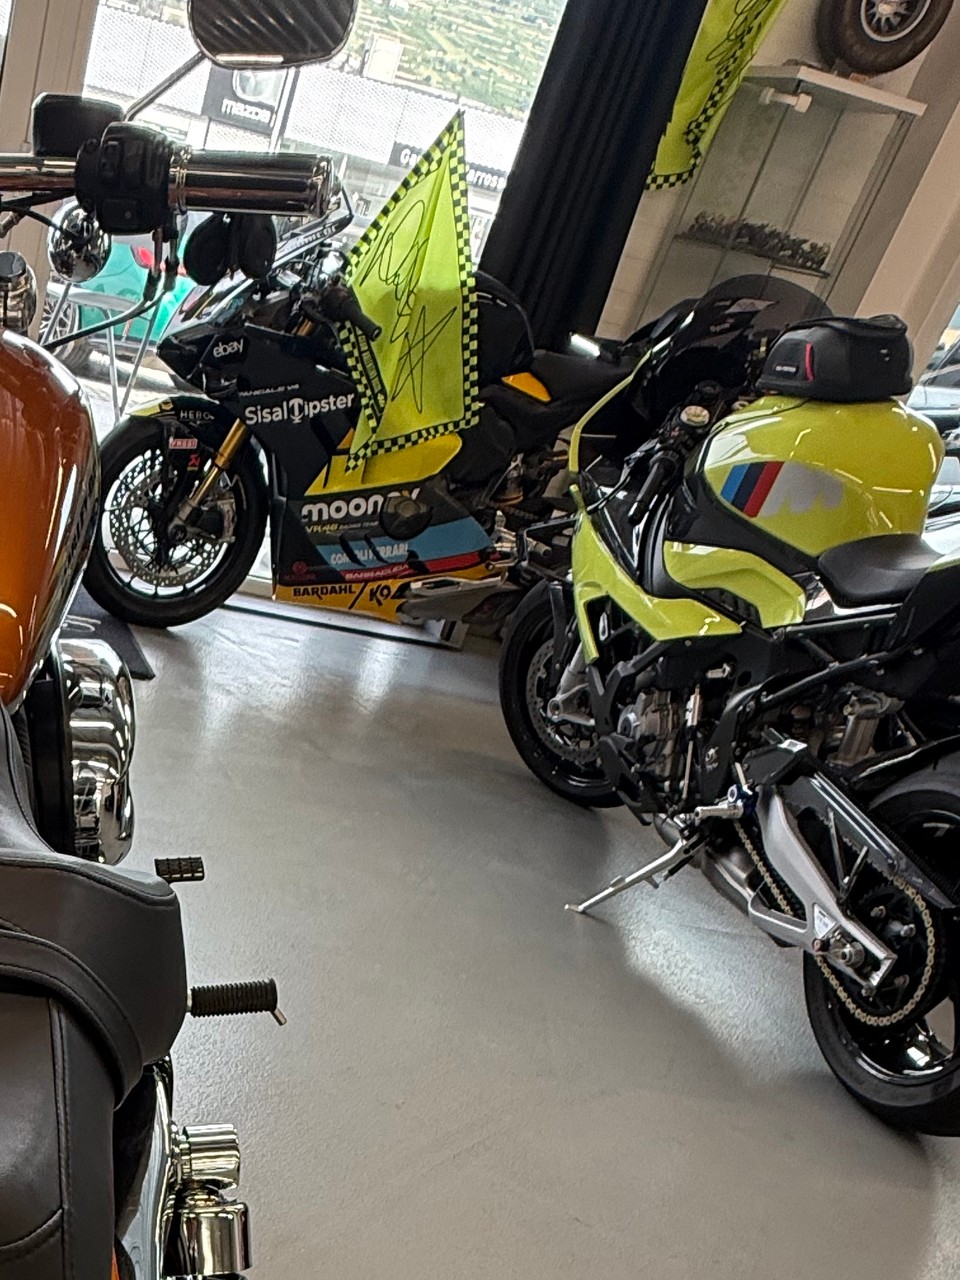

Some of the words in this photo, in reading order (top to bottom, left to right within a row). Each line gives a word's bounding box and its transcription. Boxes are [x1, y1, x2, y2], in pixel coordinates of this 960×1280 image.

[213, 339, 244, 358] ebay
[180, 410, 210, 420] HERO
[293, 584, 356, 600] BARDAHL
